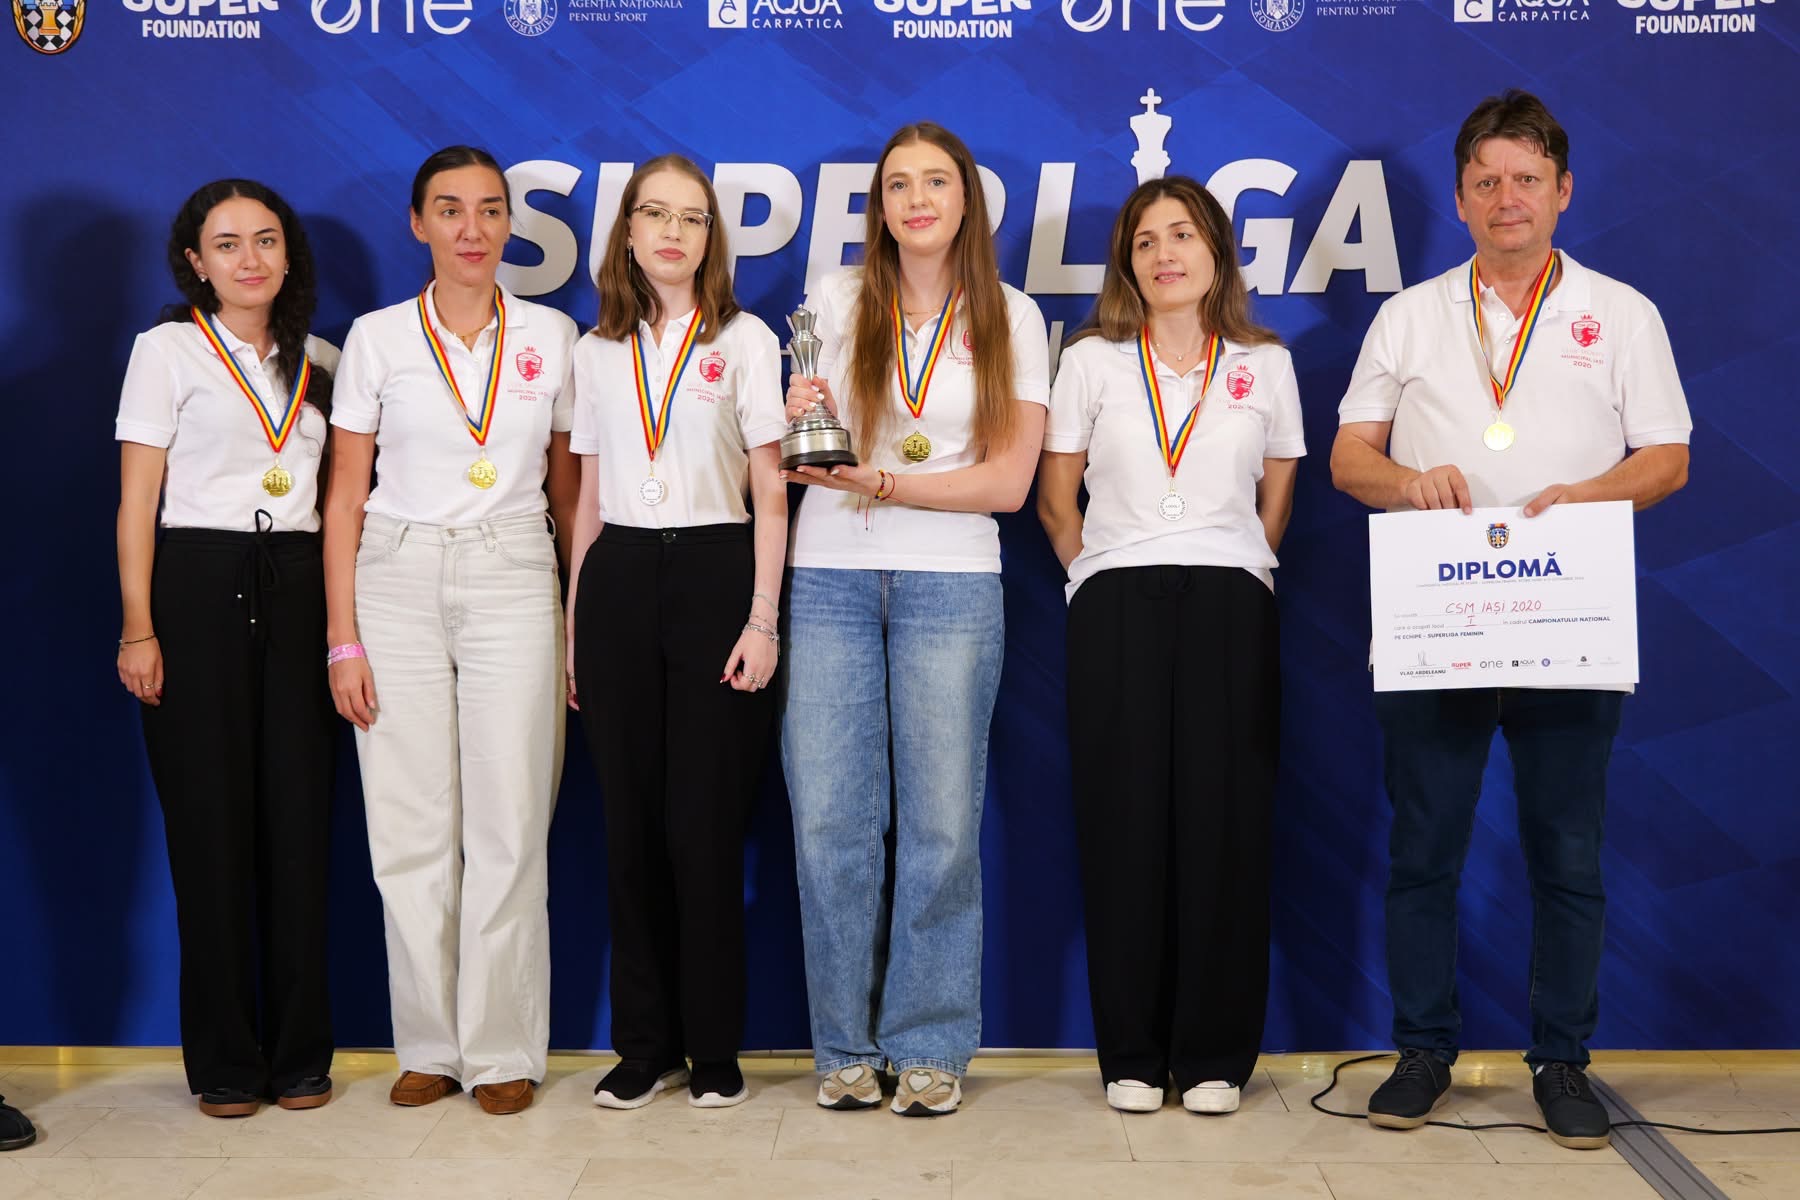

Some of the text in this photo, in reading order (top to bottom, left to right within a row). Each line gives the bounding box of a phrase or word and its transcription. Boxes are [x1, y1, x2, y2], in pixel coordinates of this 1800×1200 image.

[568, 11, 648, 22] PENTRU SPORT
[1316, 5, 1397, 16] PENTRU SPORT
[1497, 10, 1590, 22] CARPATICA
[142, 19, 261, 38] FOUNDATION
[752, 18, 843, 29] CARPATICA
[893, 19, 1013, 38] FOUNDATION
[1635, 14, 1756, 34] FOUNDATION
[1438, 552, 1562, 582] DIPLOMĂ
[1445, 602, 1474, 614] CSM
[1511, 599, 1542, 613] 2020
[1480, 660, 1504, 669] one
